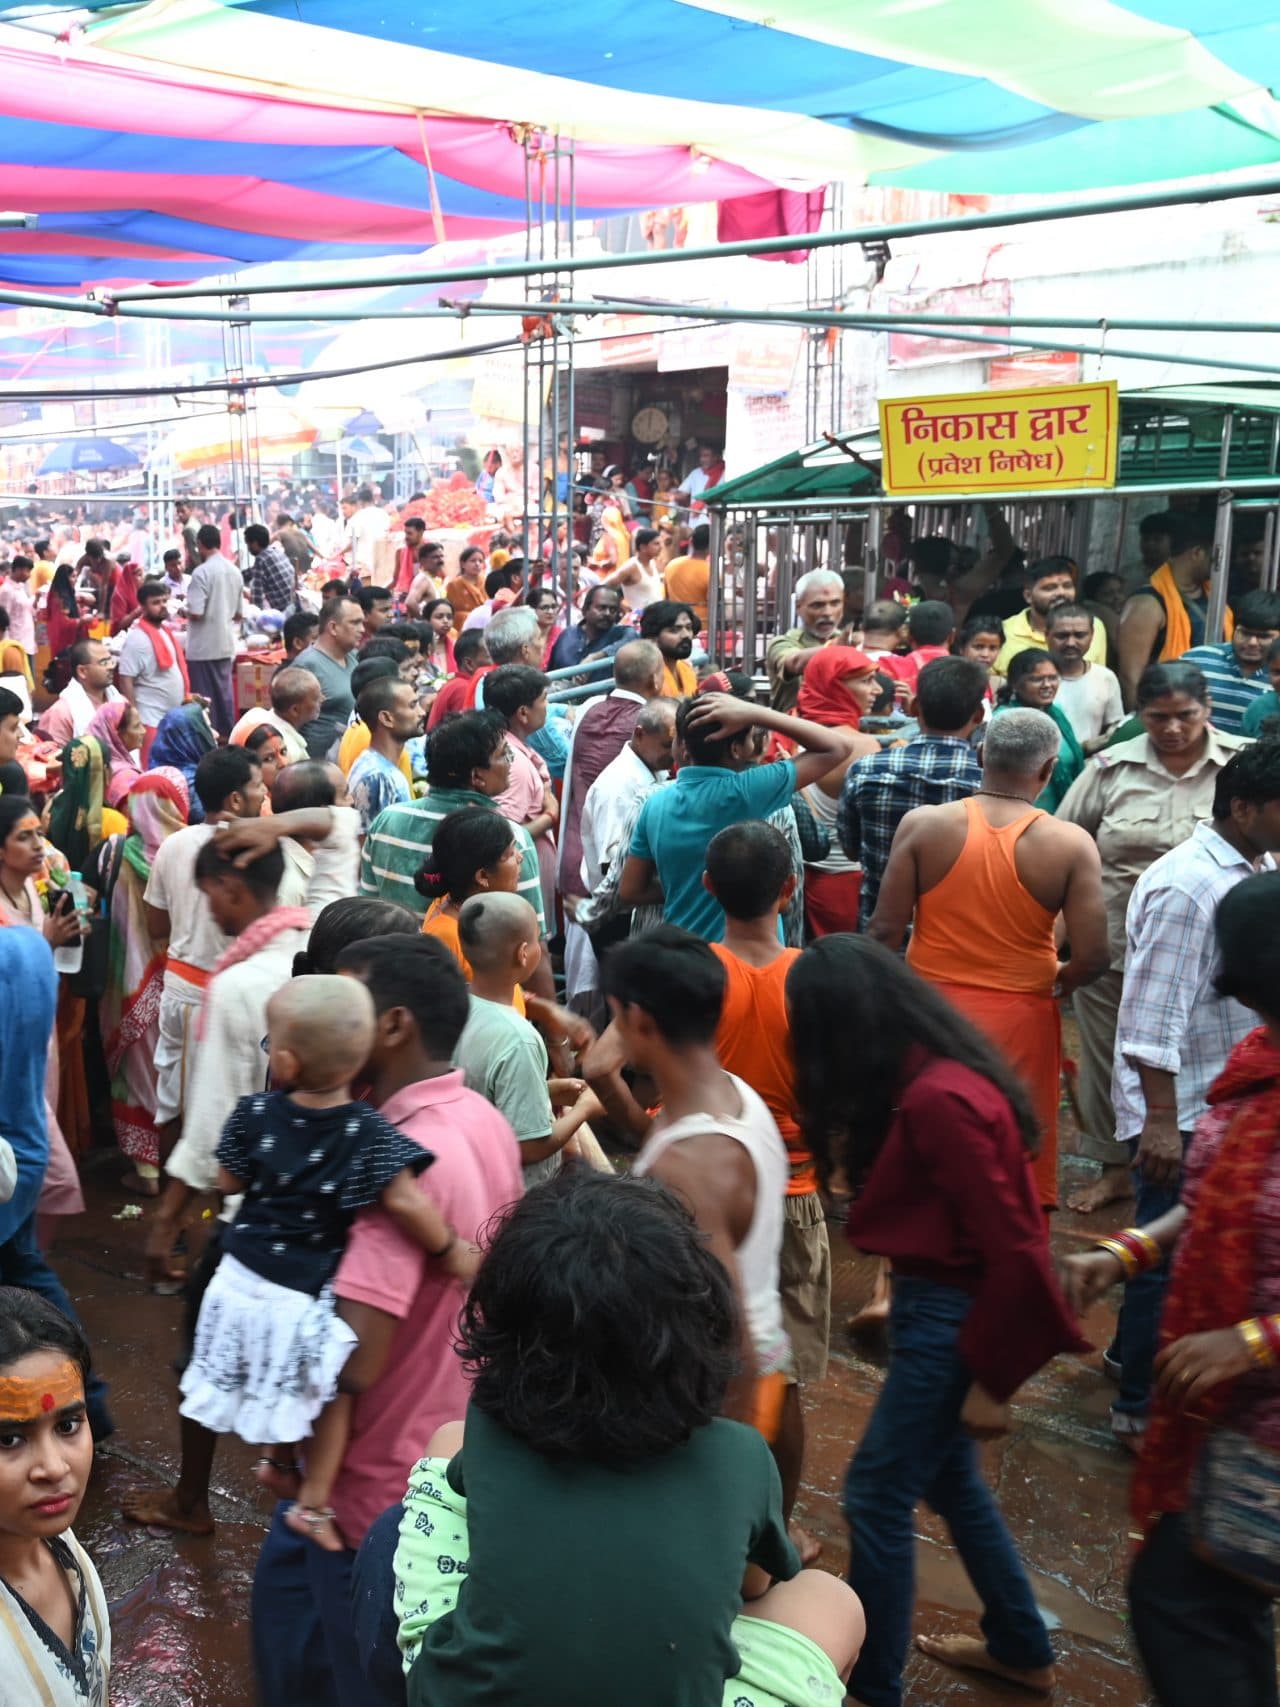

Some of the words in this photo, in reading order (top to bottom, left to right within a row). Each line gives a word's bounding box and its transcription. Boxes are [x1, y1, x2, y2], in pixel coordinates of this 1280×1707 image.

[901, 407, 1019, 445] निकास
[1028, 404, 1091, 441] द्वार
[918, 452, 981, 482] (प्रवेश
[988, 445, 1064, 477] निषेध)
